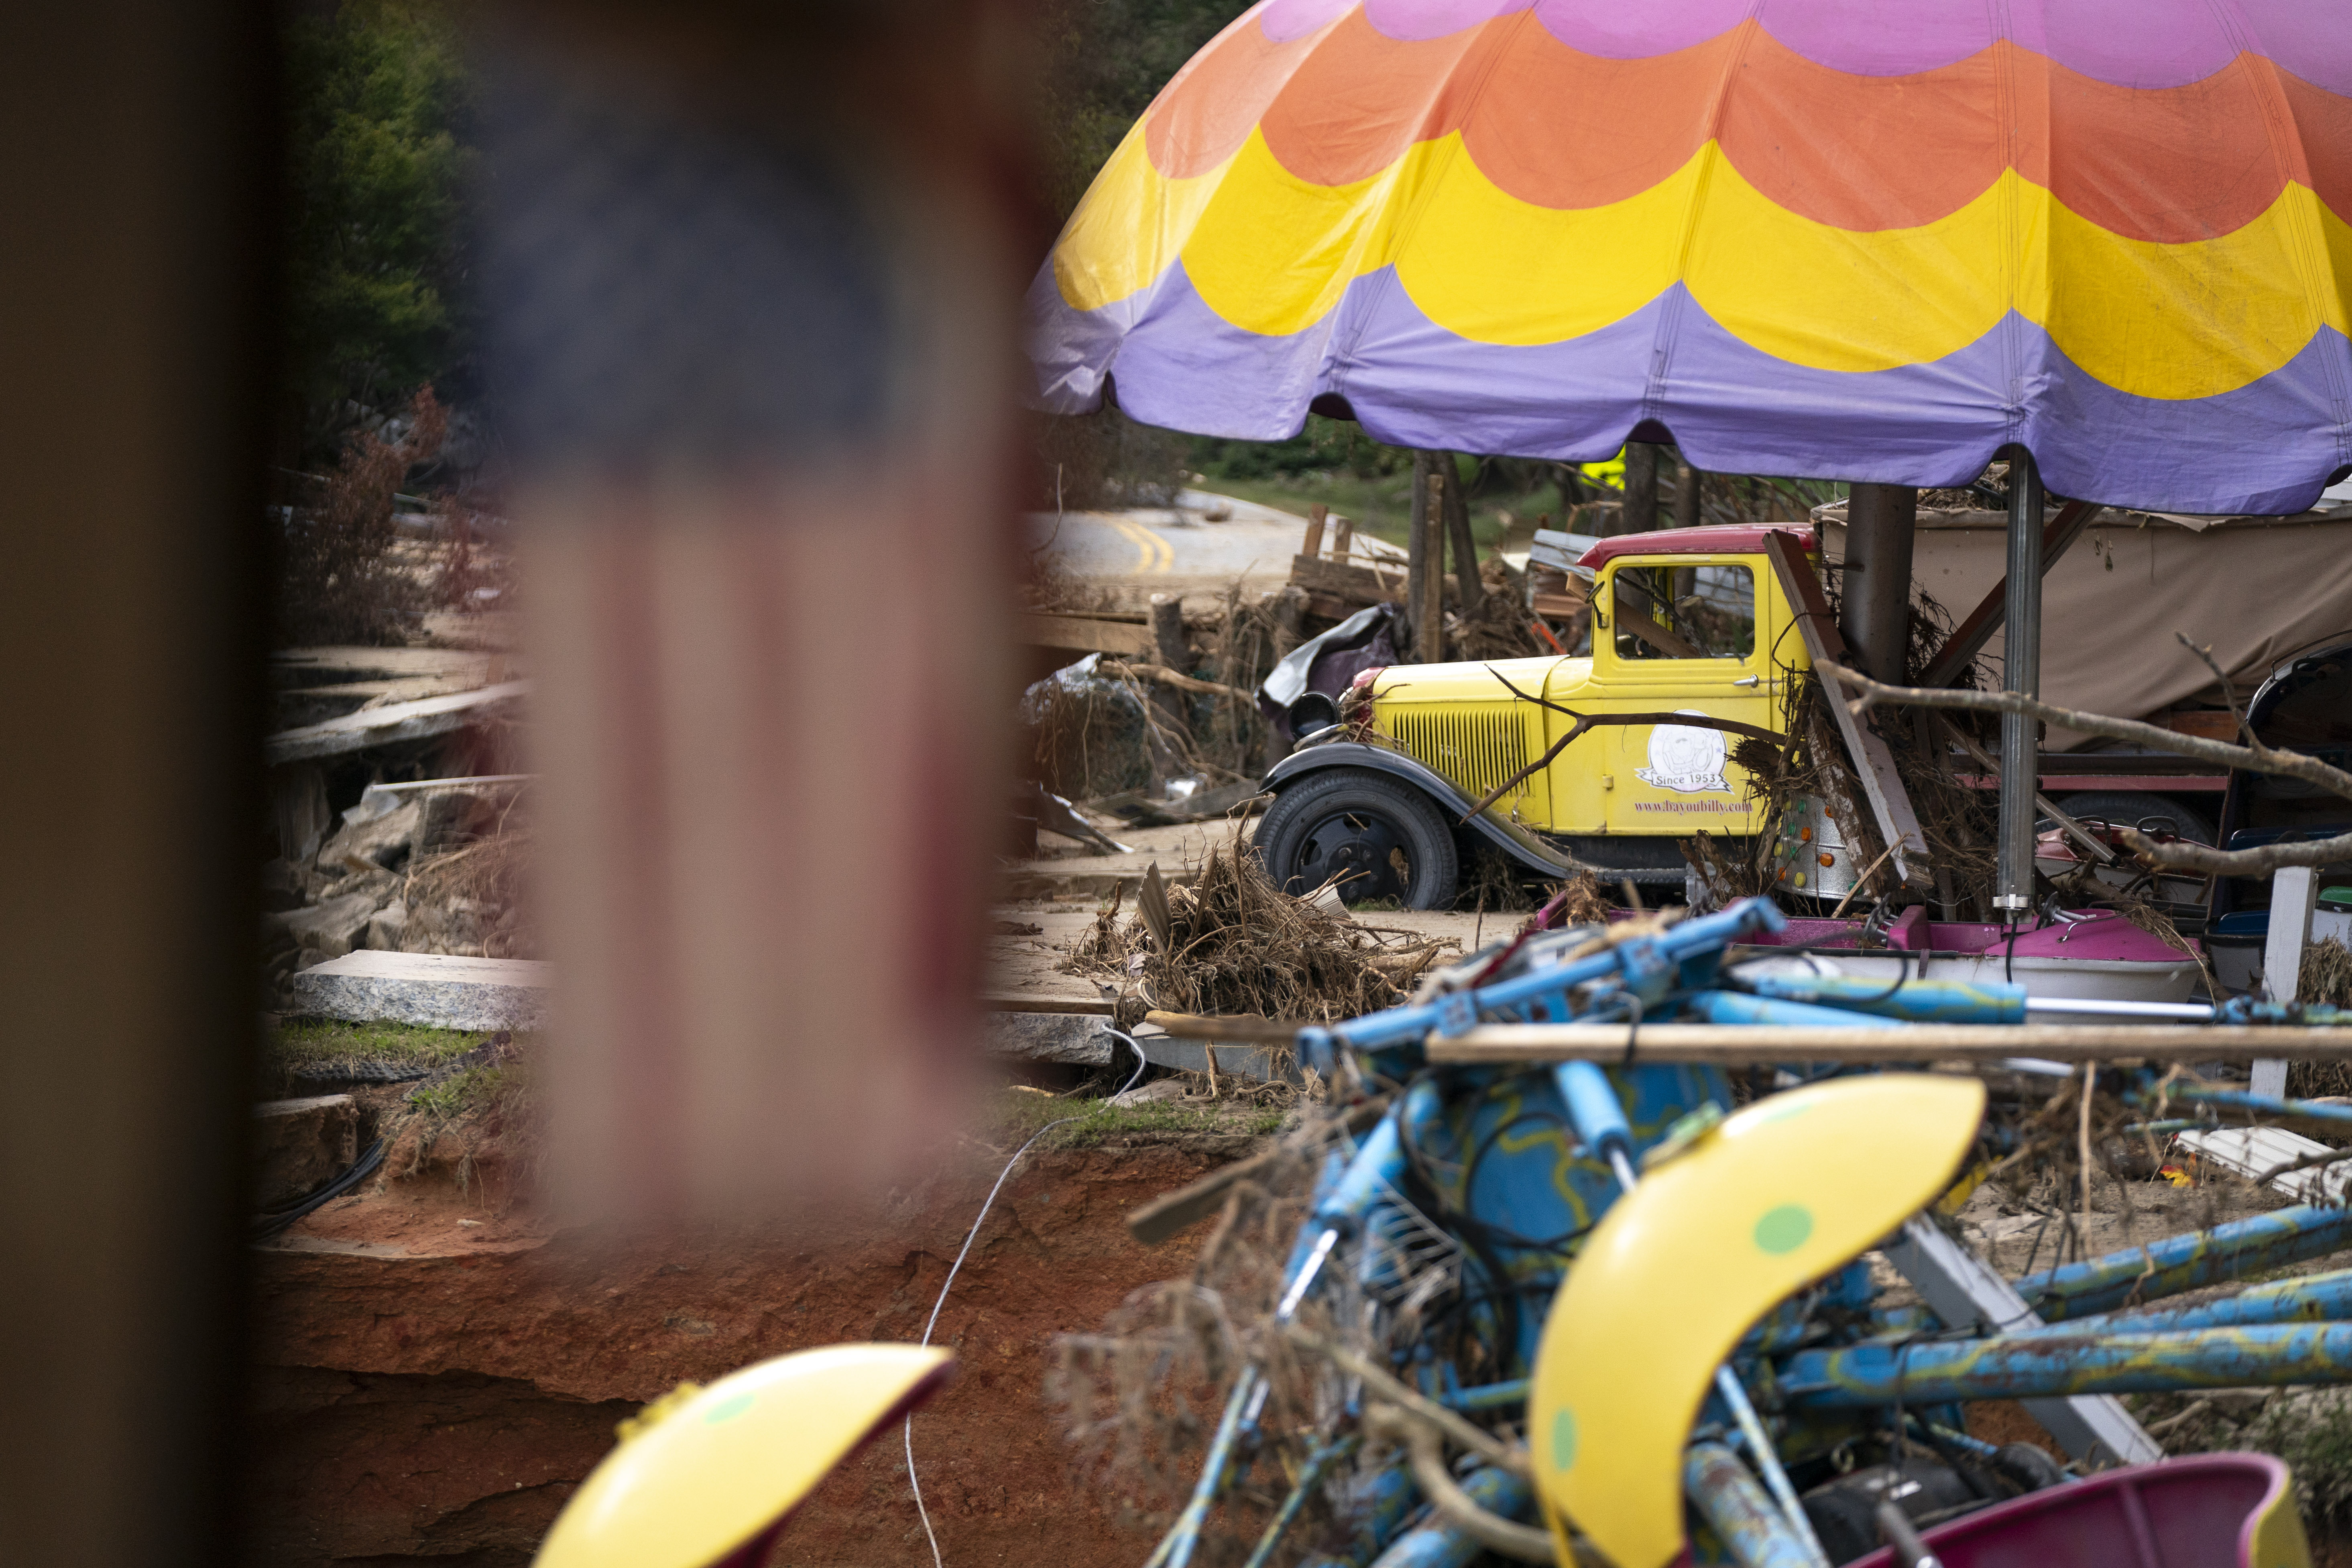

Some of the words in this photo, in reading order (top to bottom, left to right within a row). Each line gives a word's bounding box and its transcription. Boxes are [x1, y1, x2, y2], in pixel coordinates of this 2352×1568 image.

[1656, 776, 1685, 785] Since
[1690, 774, 1715, 783] 1953
[1634, 799, 1753, 815] www.bayoubilly.com
